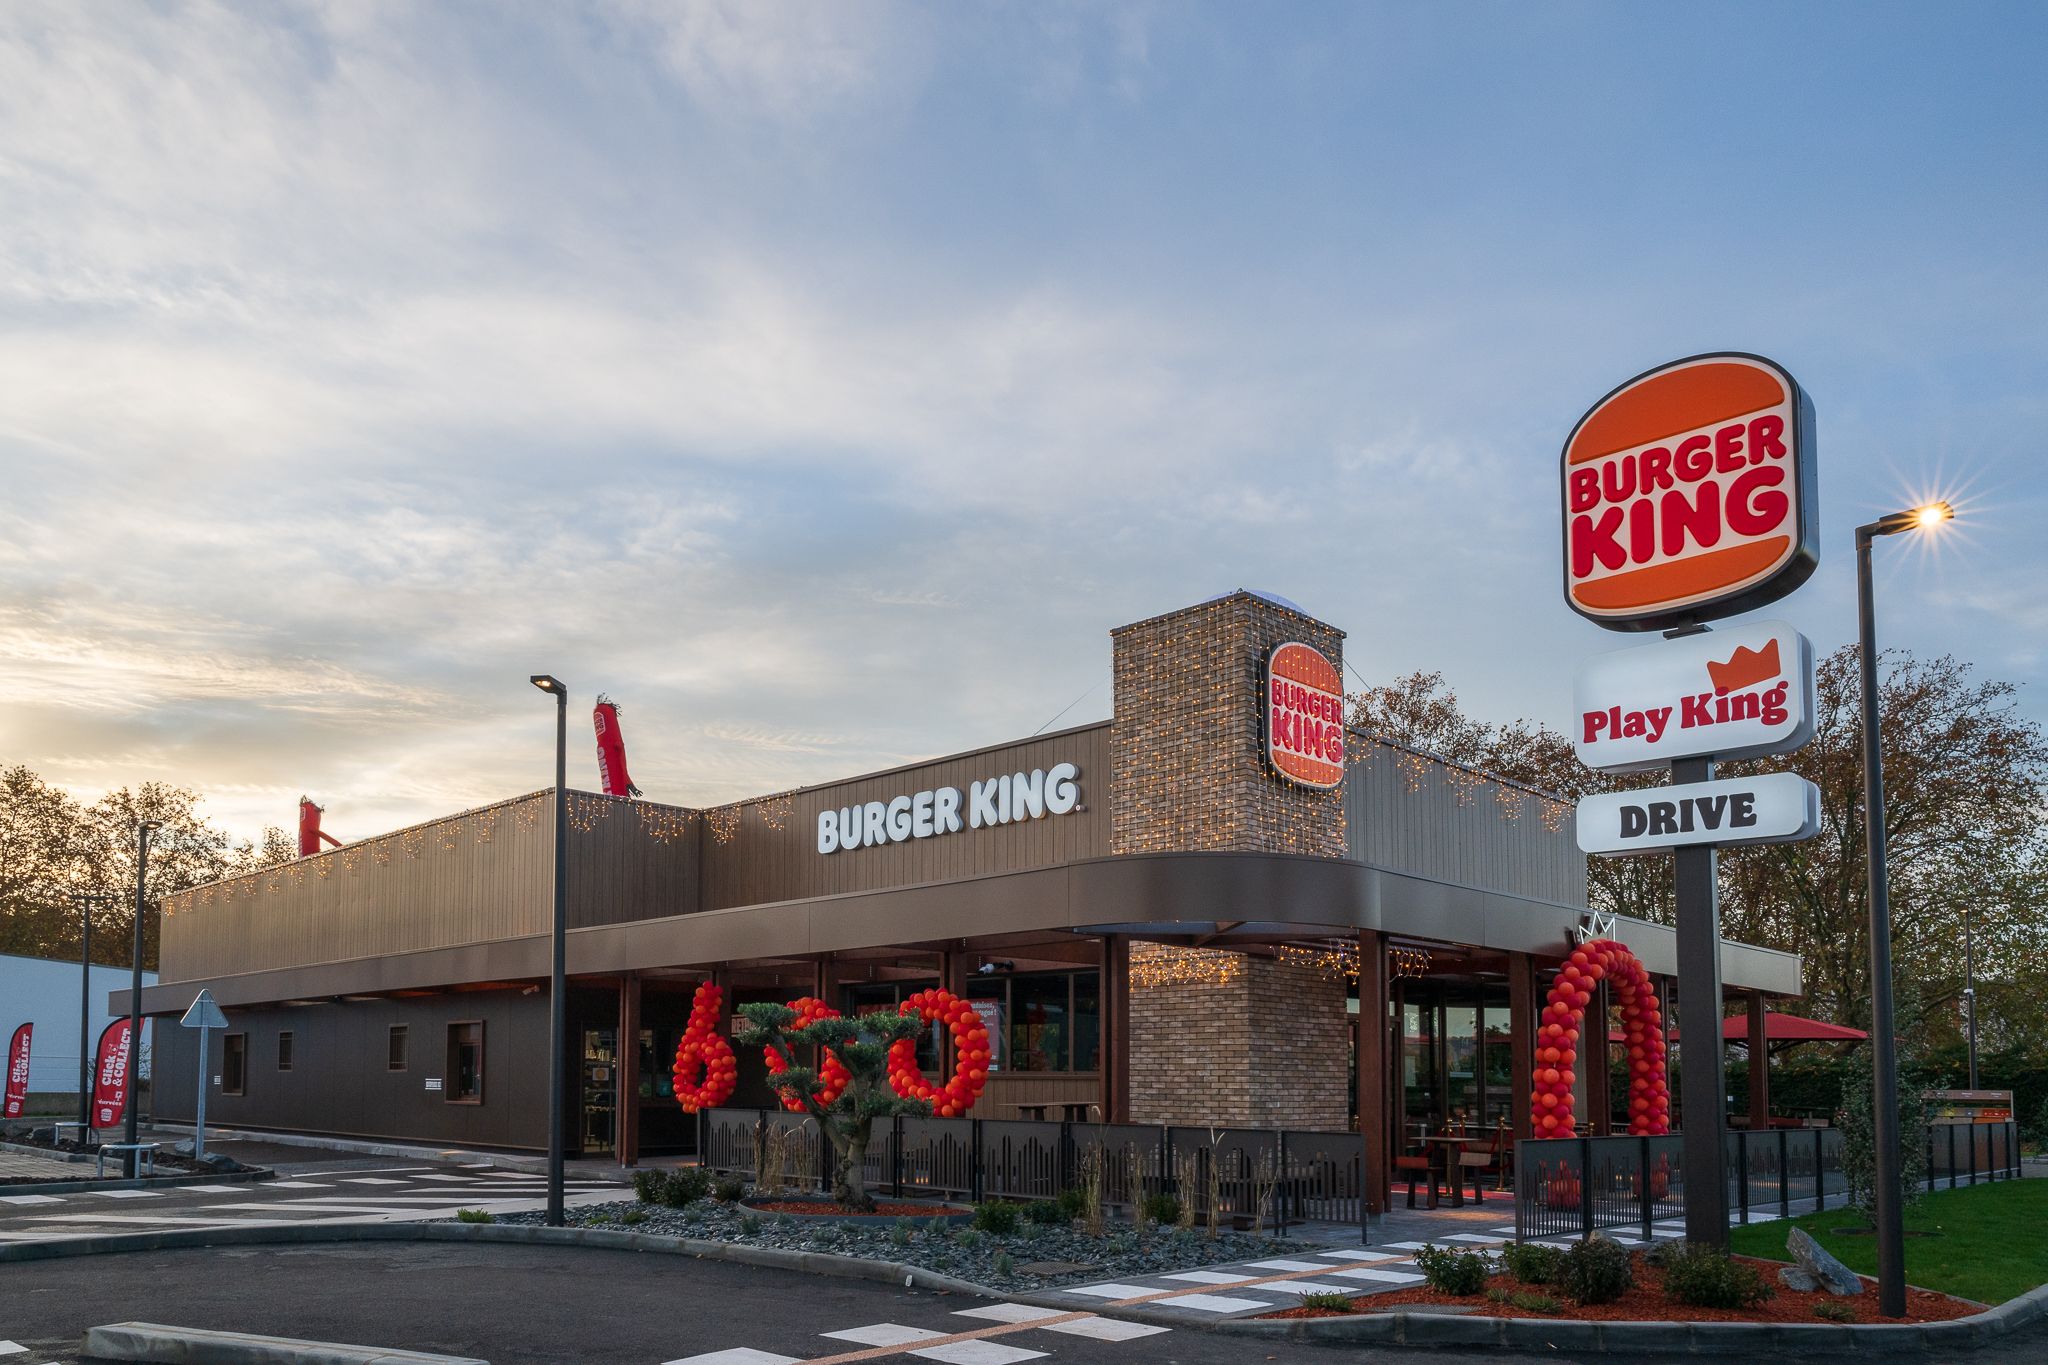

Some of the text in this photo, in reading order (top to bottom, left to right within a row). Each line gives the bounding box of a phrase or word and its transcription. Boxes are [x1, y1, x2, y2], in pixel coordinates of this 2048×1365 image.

[1569, 414, 1787, 514] BURGER
[1571, 466, 1789, 578] KING
[1271, 678, 1343, 724] BURGER
[1582, 680, 1788, 744] Play King
[1271, 707, 1343, 763] KING
[818, 762, 1081, 854] BURGER KING
[1619, 792, 1757, 839] DRIVE
[102, 1055, 116, 1086] Click
